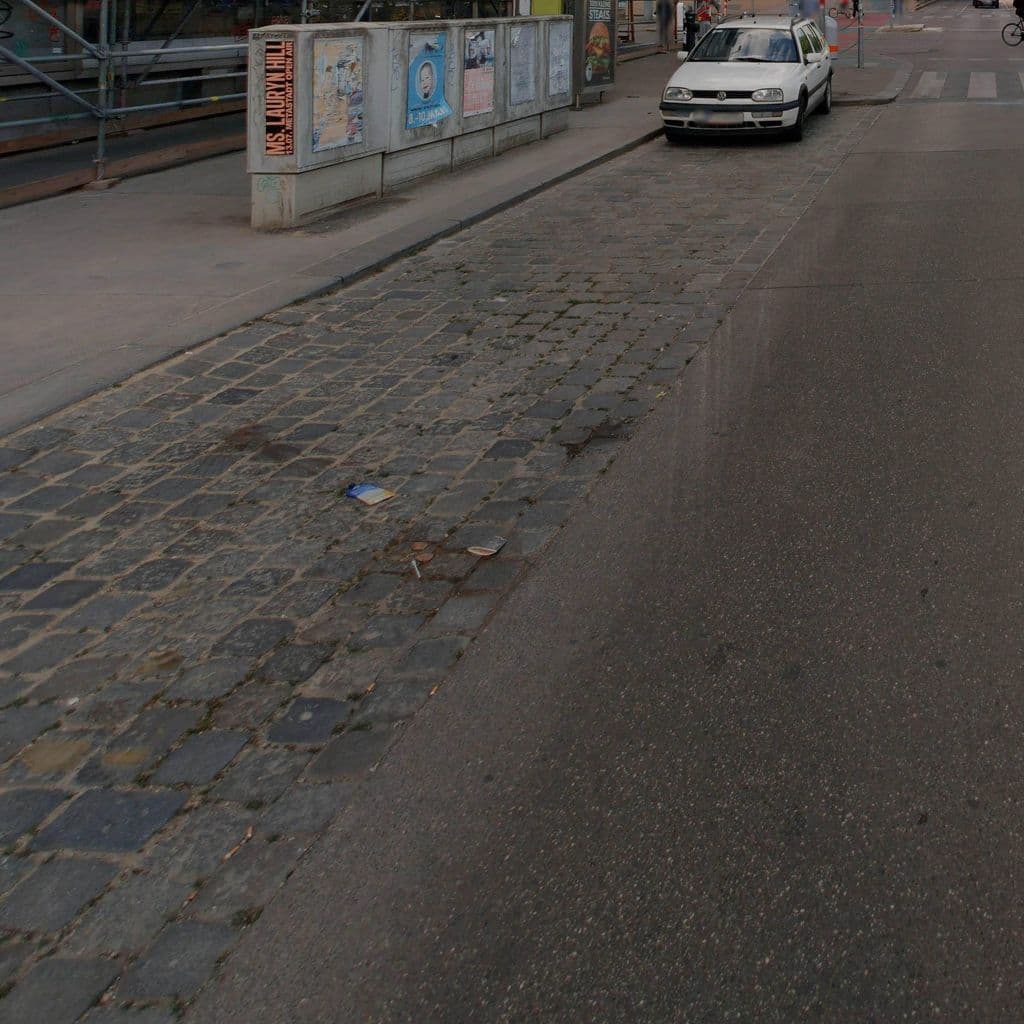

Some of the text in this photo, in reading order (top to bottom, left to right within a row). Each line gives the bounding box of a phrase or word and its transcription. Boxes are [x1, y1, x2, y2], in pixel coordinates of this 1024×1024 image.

[266, 41, 286, 69] HILL
[286, 41, 294, 56] AIR
[286, 57, 294, 80] OPEN
[266, 72, 286, 126] LAURYN
[266, 129, 286, 155] MS.
